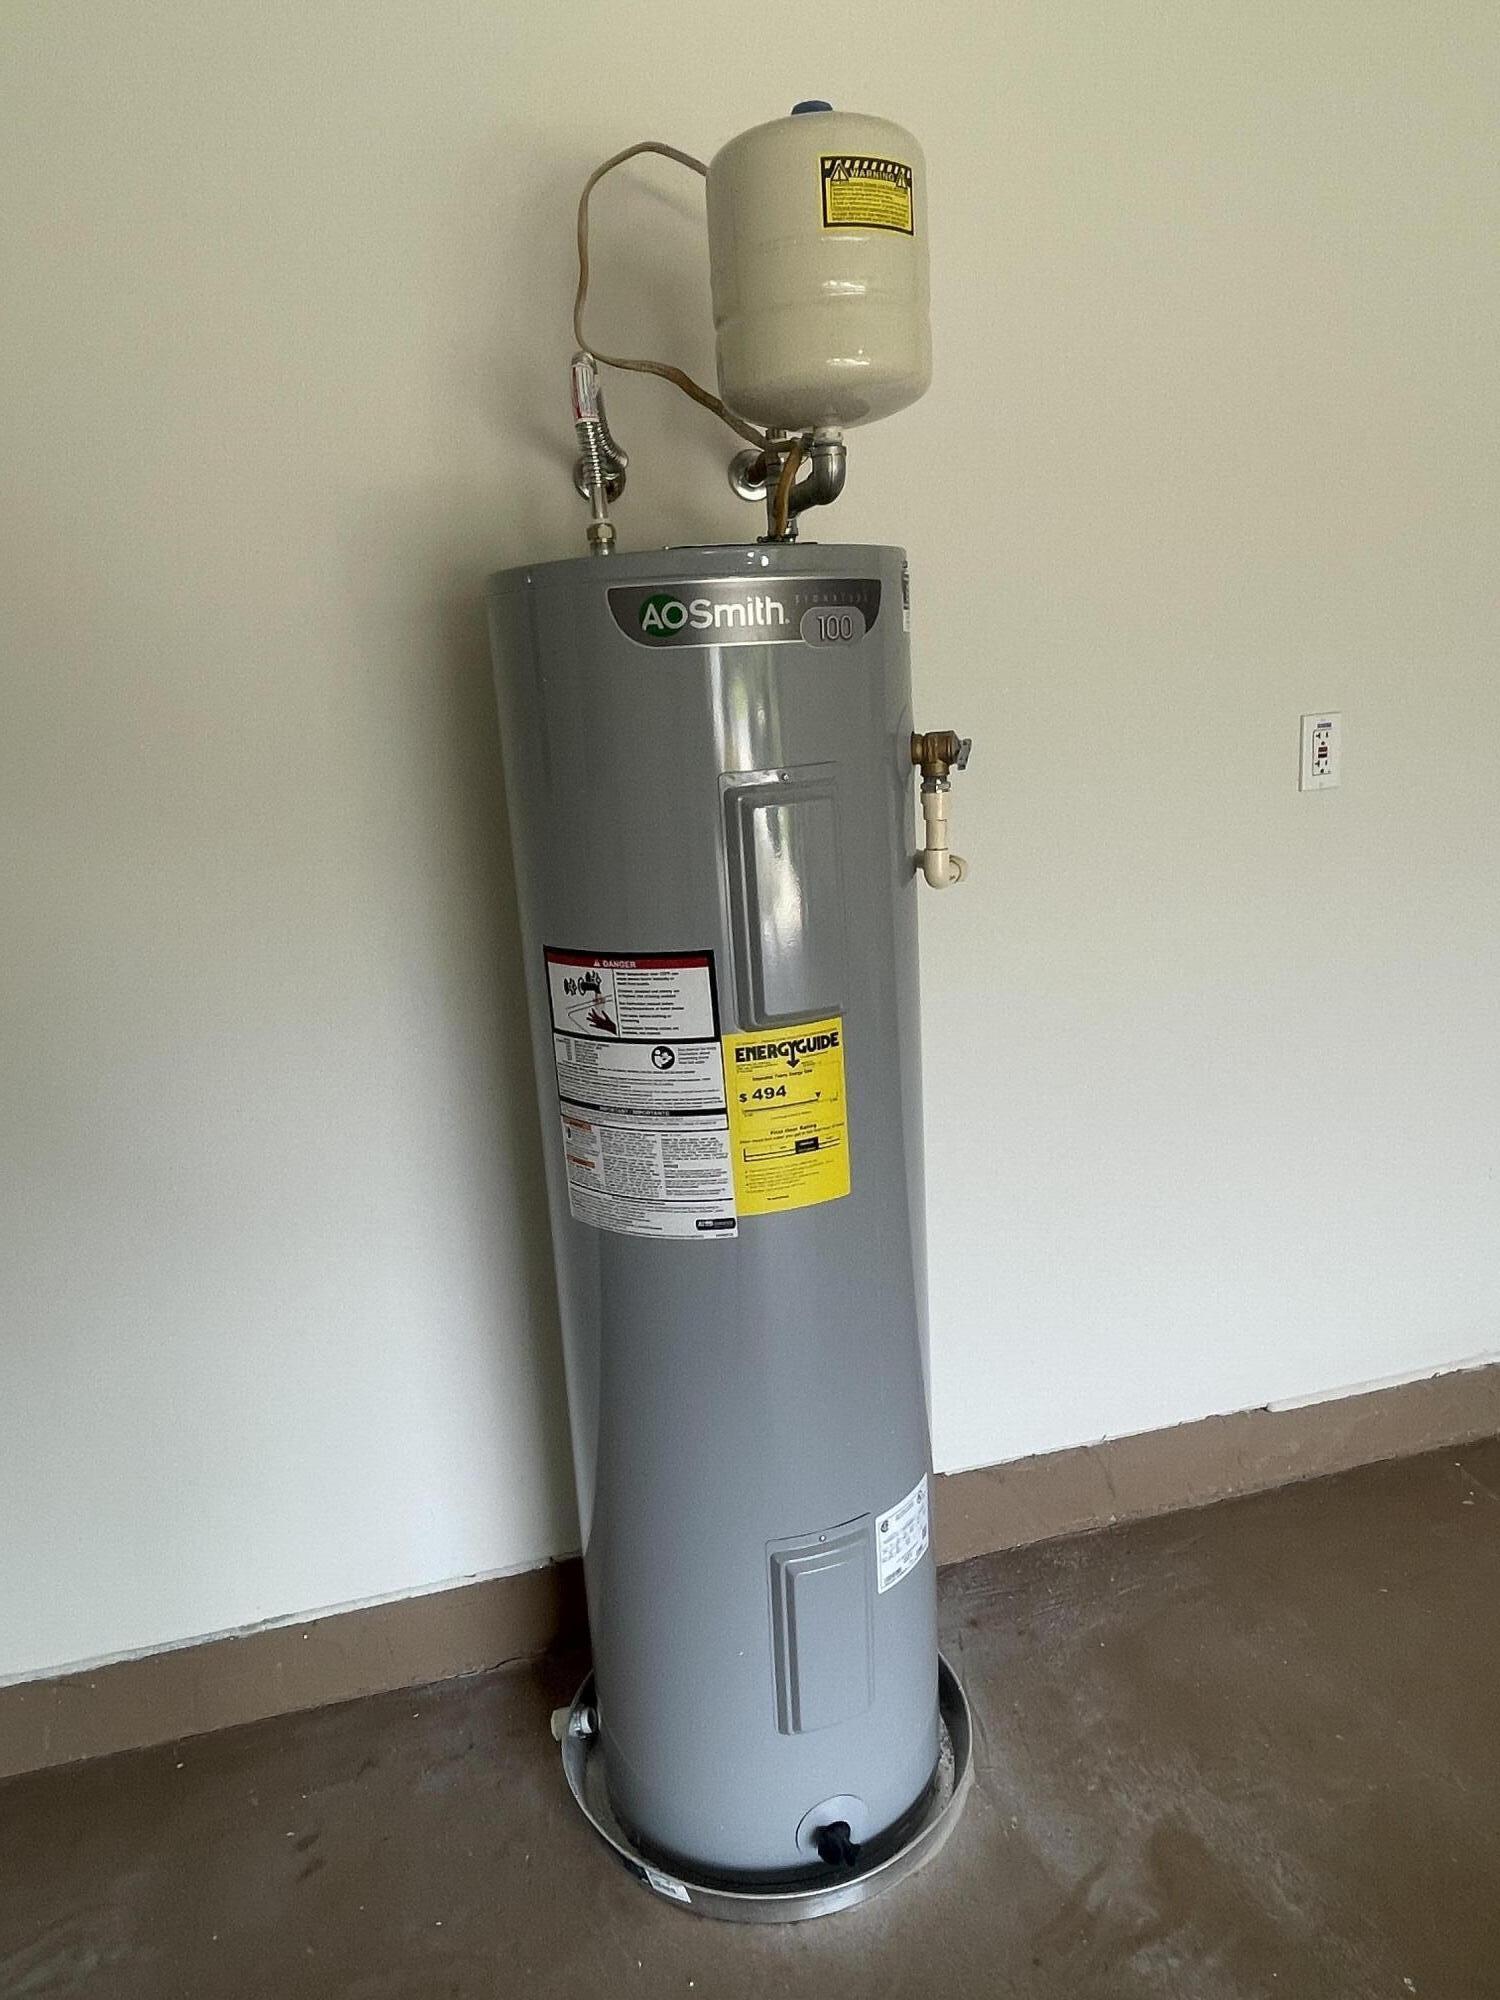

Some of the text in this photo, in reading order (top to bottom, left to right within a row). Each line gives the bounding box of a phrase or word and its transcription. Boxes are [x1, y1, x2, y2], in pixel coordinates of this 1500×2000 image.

[850, 168, 895, 181] WARNING
[817, 614, 853, 640] 100
[602, 959, 637, 968] DANGER
[752, 1085, 787, 1101] 494
